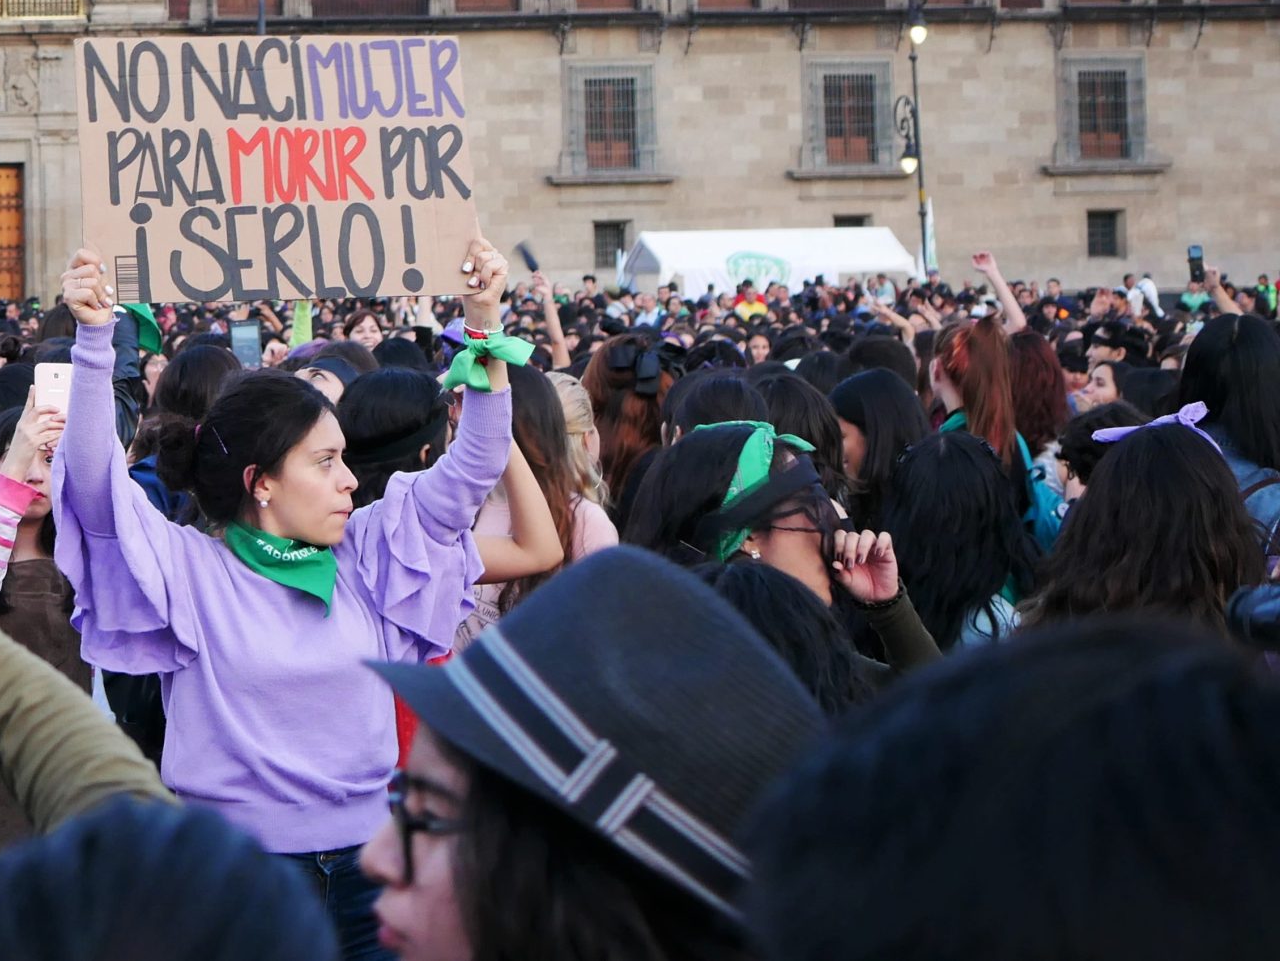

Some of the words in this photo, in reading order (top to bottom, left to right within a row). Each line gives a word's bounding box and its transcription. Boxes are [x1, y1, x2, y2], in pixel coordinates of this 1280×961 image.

[83, 40, 170, 123] NO
[307, 38, 466, 121] MUJER
[107, 127, 226, 207] PARA
[227, 125, 376, 204] MORIR
[379, 124, 472, 201] POR
